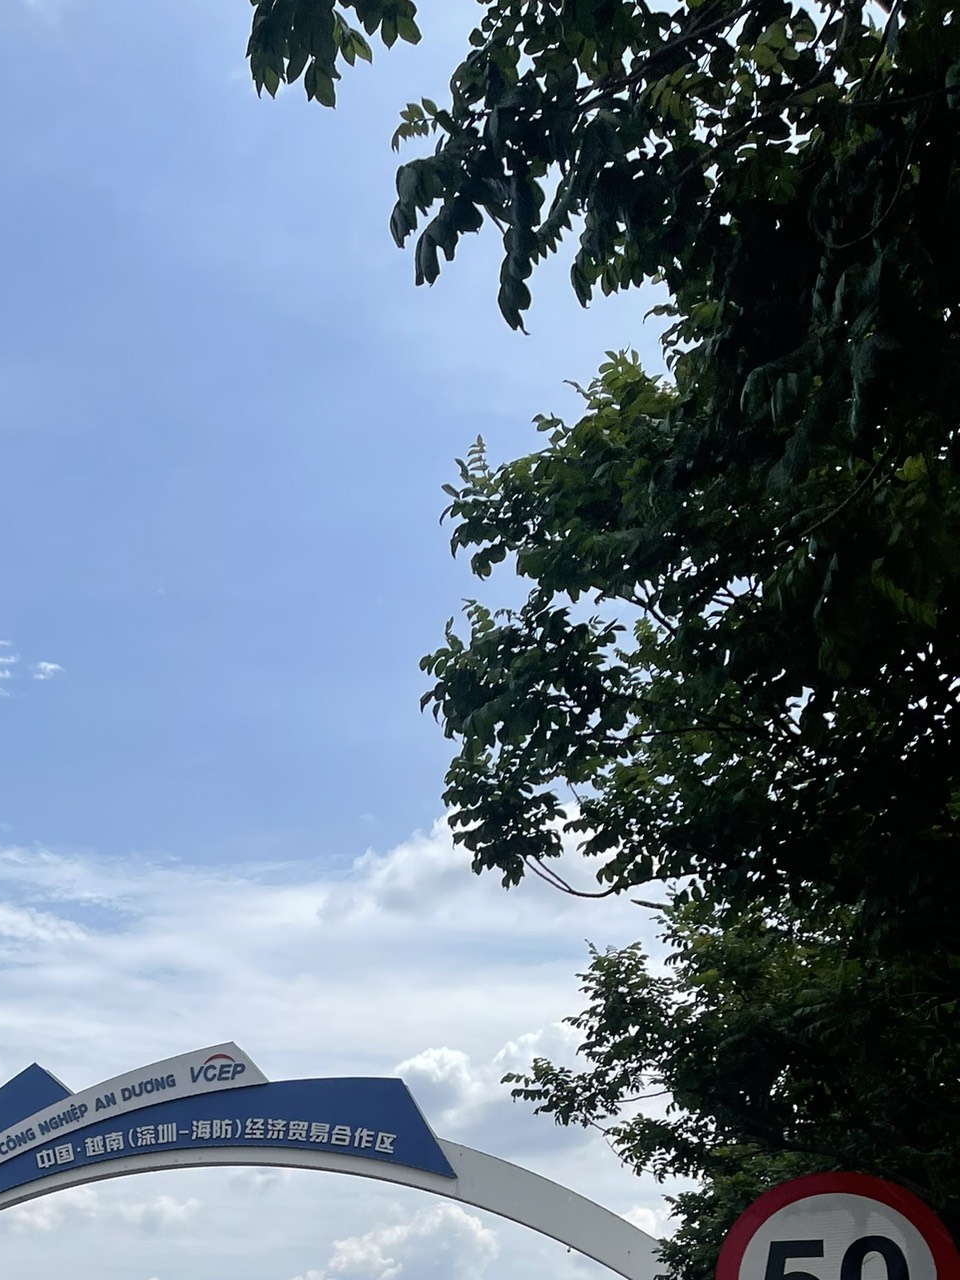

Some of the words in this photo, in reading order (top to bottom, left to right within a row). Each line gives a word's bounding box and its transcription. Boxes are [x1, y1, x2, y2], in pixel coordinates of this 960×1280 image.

[190, 1063, 246, 1083] VCEP
[38, 1104, 89, 1136] NGHIỆP
[95, 1092, 117, 1112] AN
[120, 1073, 177, 1102] DƯƠNG
